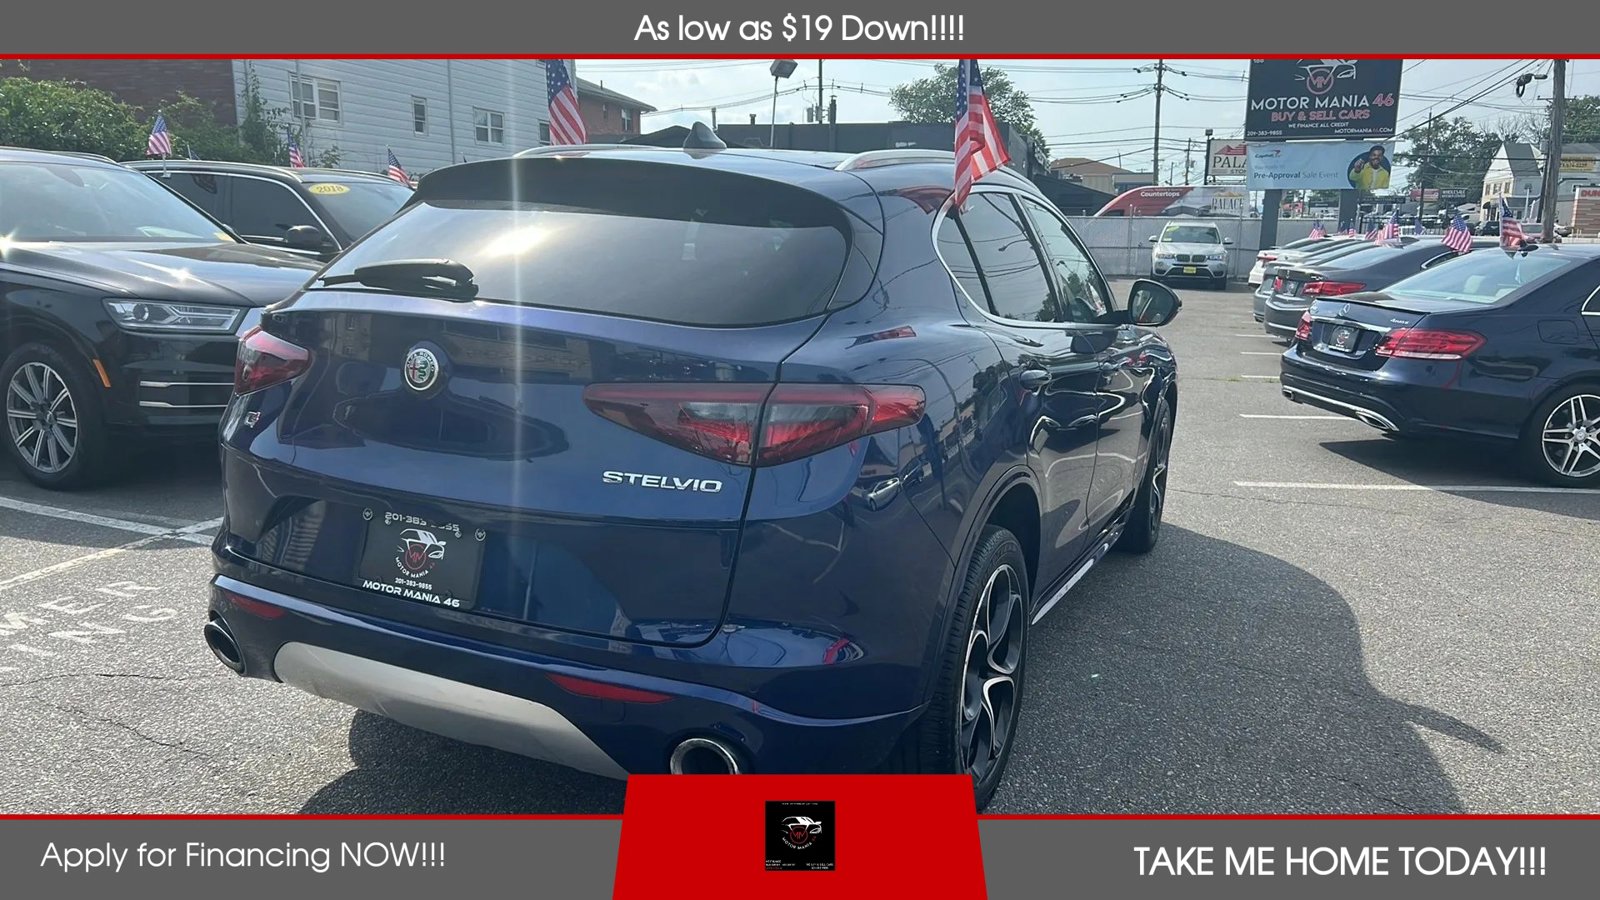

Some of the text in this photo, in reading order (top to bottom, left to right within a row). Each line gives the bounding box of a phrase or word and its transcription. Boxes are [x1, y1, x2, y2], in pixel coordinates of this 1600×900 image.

[1251, 93, 1395, 111] MOTOR MANIA 46
[1271, 109, 1370, 122] BUY & SELL CARS
[1254, 172, 1301, 180] Pre-Approval
[316, 185, 344, 193] 2018
[1211, 198, 1244, 211] PALACE
[602, 470, 722, 493] STELVIO
[395, 556, 410, 576] MOTOR
[410, 569, 429, 578] MANIA
[362, 580, 460, 608] MOTOR MANIA 46
